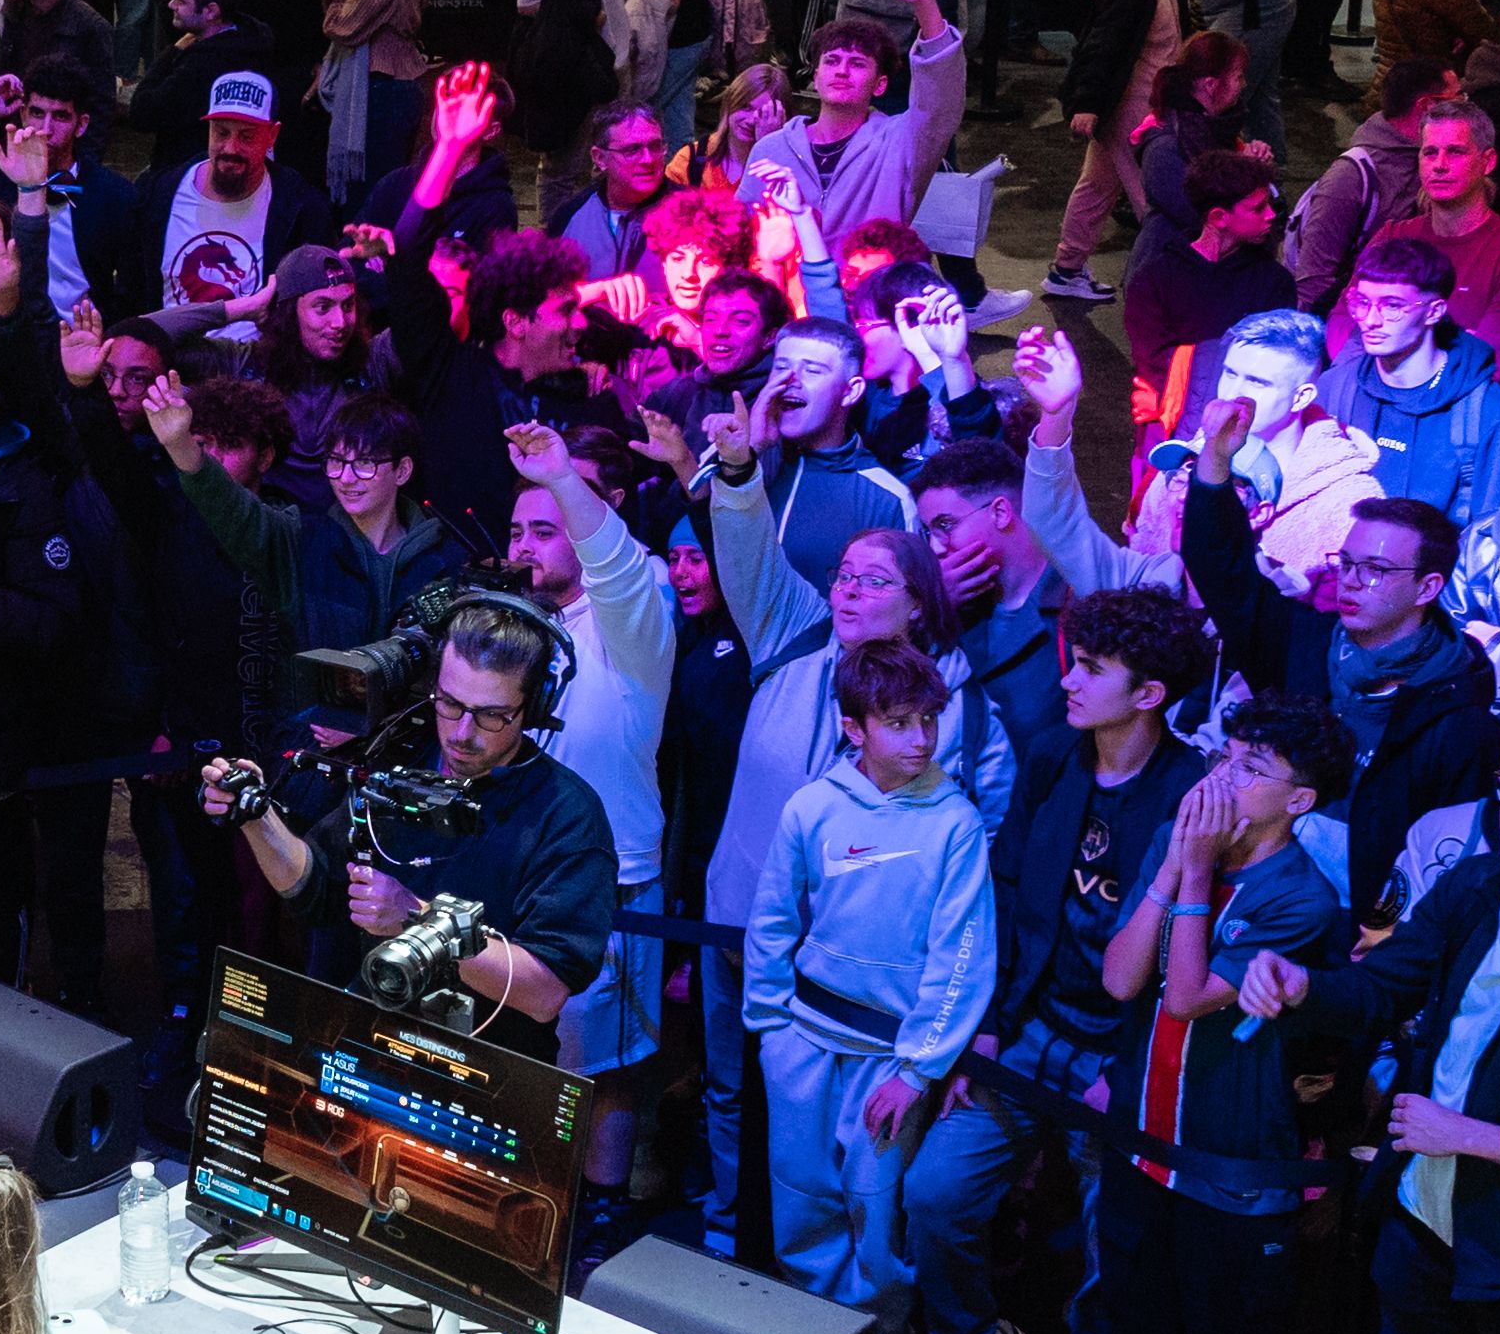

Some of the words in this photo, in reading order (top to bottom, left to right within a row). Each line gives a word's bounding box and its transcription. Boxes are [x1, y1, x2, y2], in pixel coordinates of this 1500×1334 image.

[1376, 436, 1407, 453] GUESS
[831, 962, 868, 1033] ATHLETIC
[859, 918, 878, 964] DEPT.
